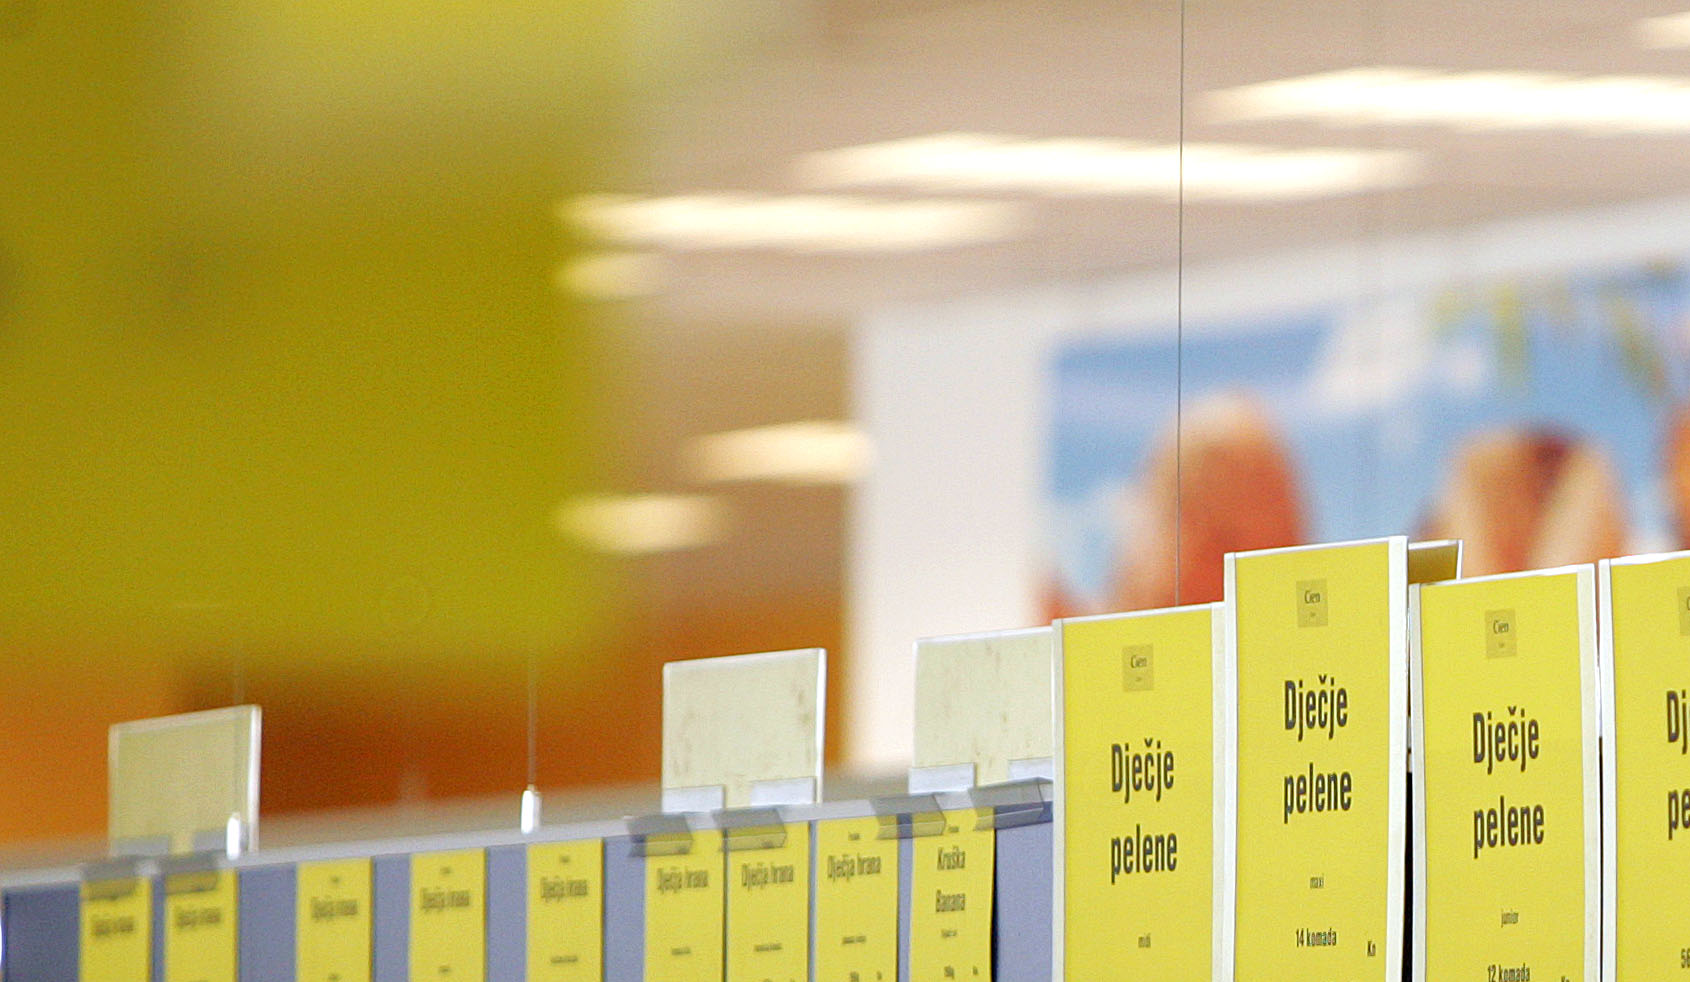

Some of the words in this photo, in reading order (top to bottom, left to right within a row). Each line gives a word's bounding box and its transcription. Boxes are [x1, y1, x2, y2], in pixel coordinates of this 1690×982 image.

[1284, 673, 1348, 742] Dječje
[1111, 737, 1174, 804] Dječje
[1472, 705, 1540, 776] Dječje
[1284, 761, 1352, 824] pelene
[936, 844, 966, 871] Kruška
[1111, 823, 1178, 886] pelene
[1473, 795, 1545, 859] pelene
[856, 852, 881, 876] hrana
[935, 889, 966, 913] Banana
[1296, 929, 1305, 948] 14
[1306, 928, 1337, 947] komada
